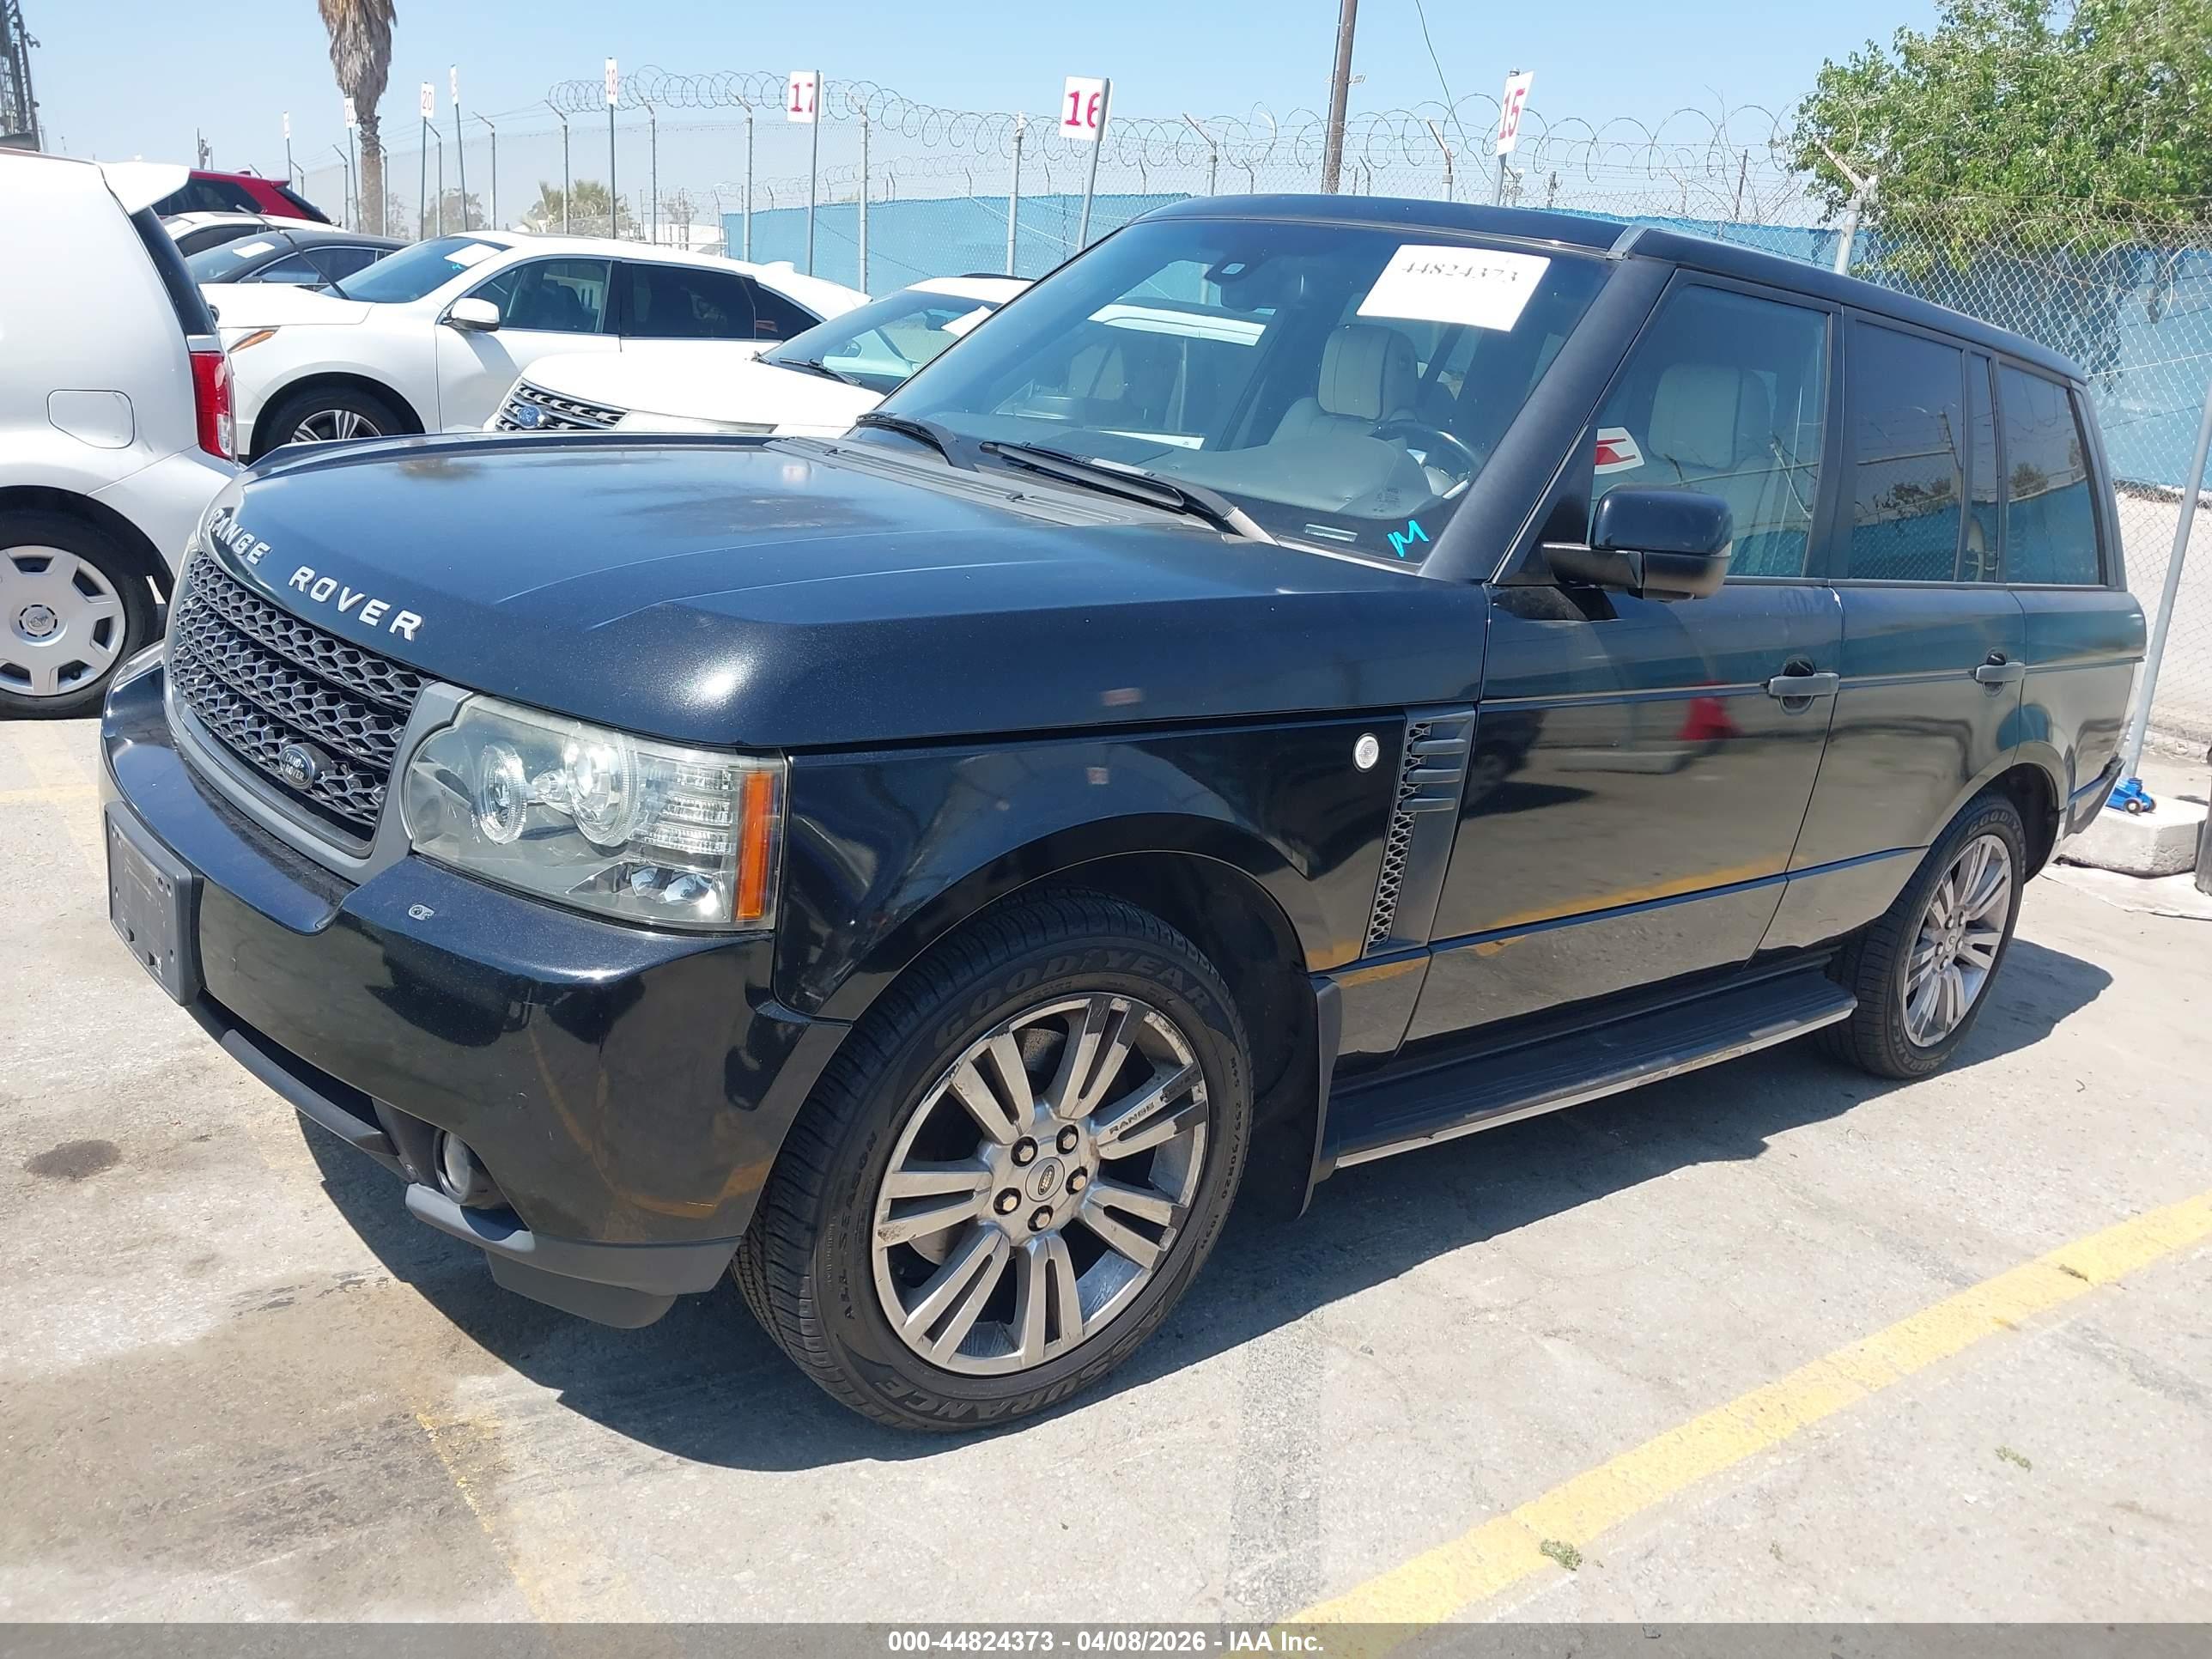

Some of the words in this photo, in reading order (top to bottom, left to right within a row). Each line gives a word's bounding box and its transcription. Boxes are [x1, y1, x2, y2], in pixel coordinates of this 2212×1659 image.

[422, 90, 433, 110] 20
[607, 69, 617, 95] 18
[790, 82, 814, 112] 17
[1065, 90, 1100, 129] 16
[1498, 88, 1526, 140] 15
[1401, 261, 1519, 283] 44824373
[206, 507, 272, 565] RANGE
[288, 565, 424, 641] ROVER
[284, 763, 305, 782] ROVER
[285, 752, 302, 769] LAND
[934, 949, 1212, 1048] GOODYEAR
[1108, 1100, 1157, 1136] RANGE
[838, 1130, 878, 1321] ALL-SEASON
[874, 1296, 1167, 1420] ASSURANCE
